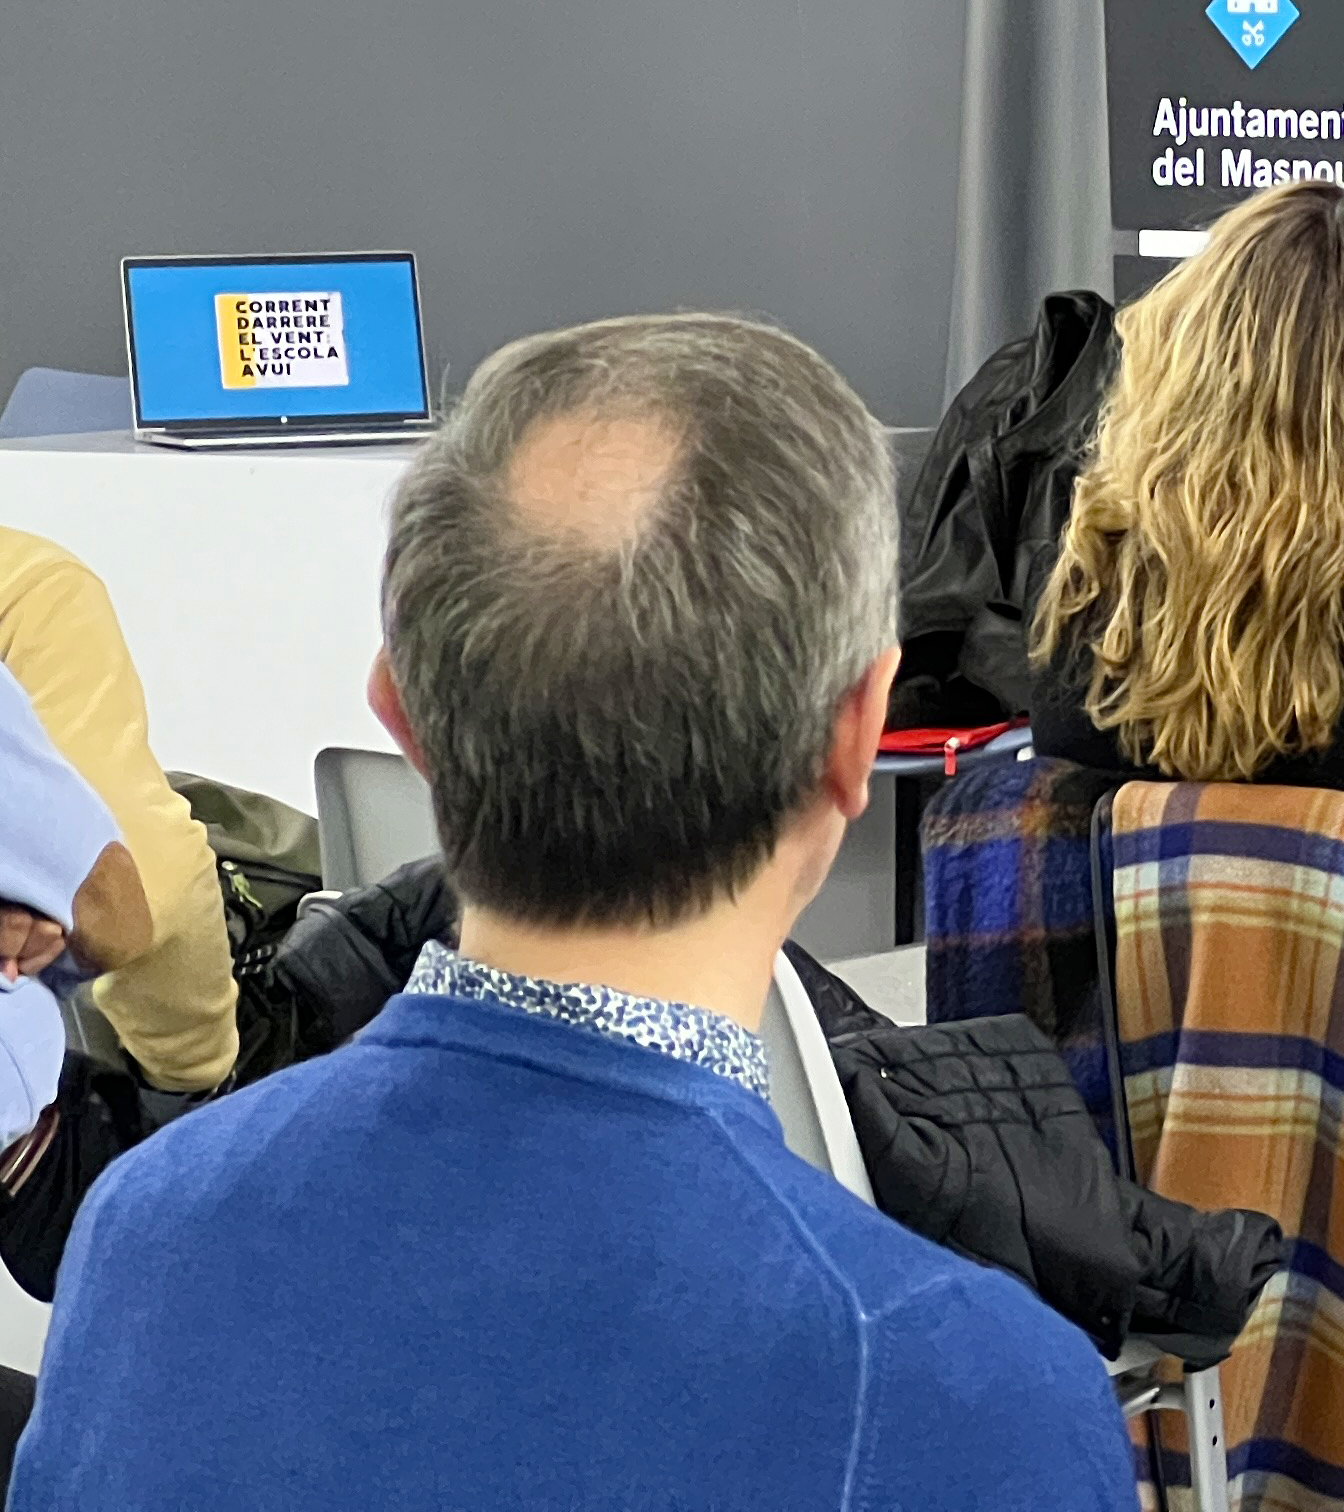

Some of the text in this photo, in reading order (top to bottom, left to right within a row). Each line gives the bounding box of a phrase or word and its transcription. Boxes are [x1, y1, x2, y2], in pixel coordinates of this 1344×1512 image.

[1152, 147, 1205, 187] del
[235, 299, 331, 314] CORRENT
[237, 314, 331, 330] DARRERE
[239, 332, 262, 345] EL
[242, 363, 291, 377] AVUI
